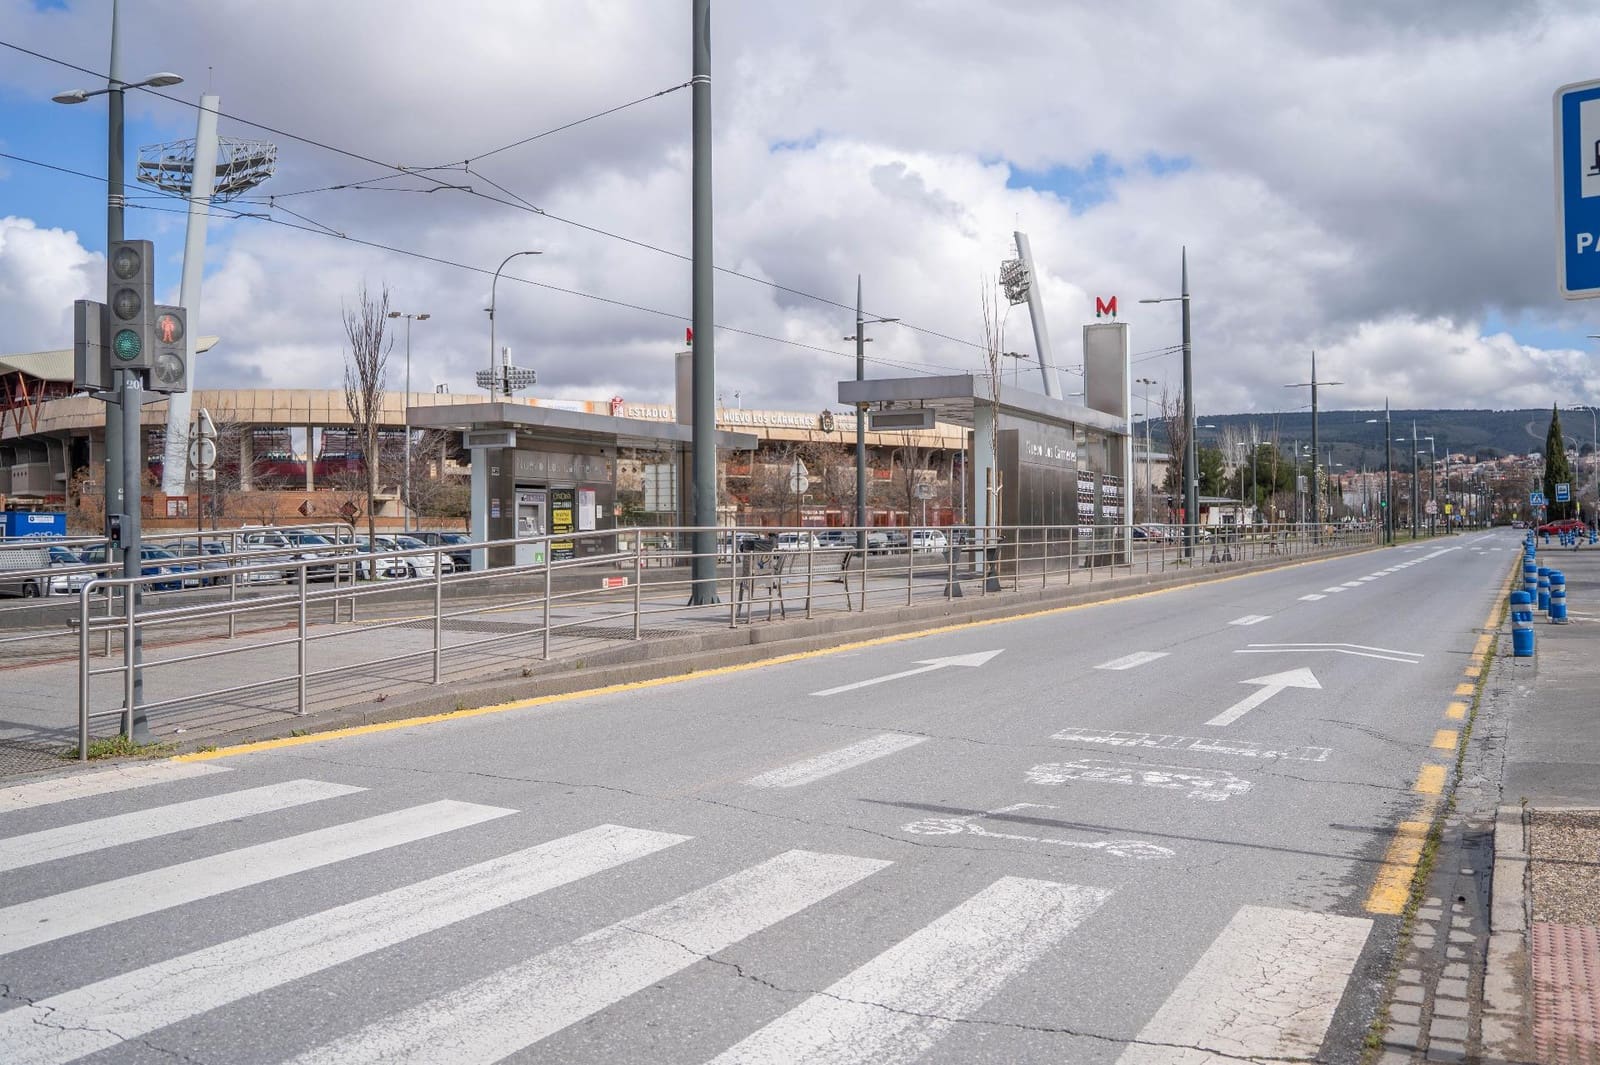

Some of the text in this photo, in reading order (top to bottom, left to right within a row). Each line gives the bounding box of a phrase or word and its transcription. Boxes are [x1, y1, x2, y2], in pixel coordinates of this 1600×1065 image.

[1096, 296, 1117, 317] M
[628, 407, 668, 418] ESTADIO
[723, 411, 750, 423] NUEVO
[752, 414, 768, 424] LOS
